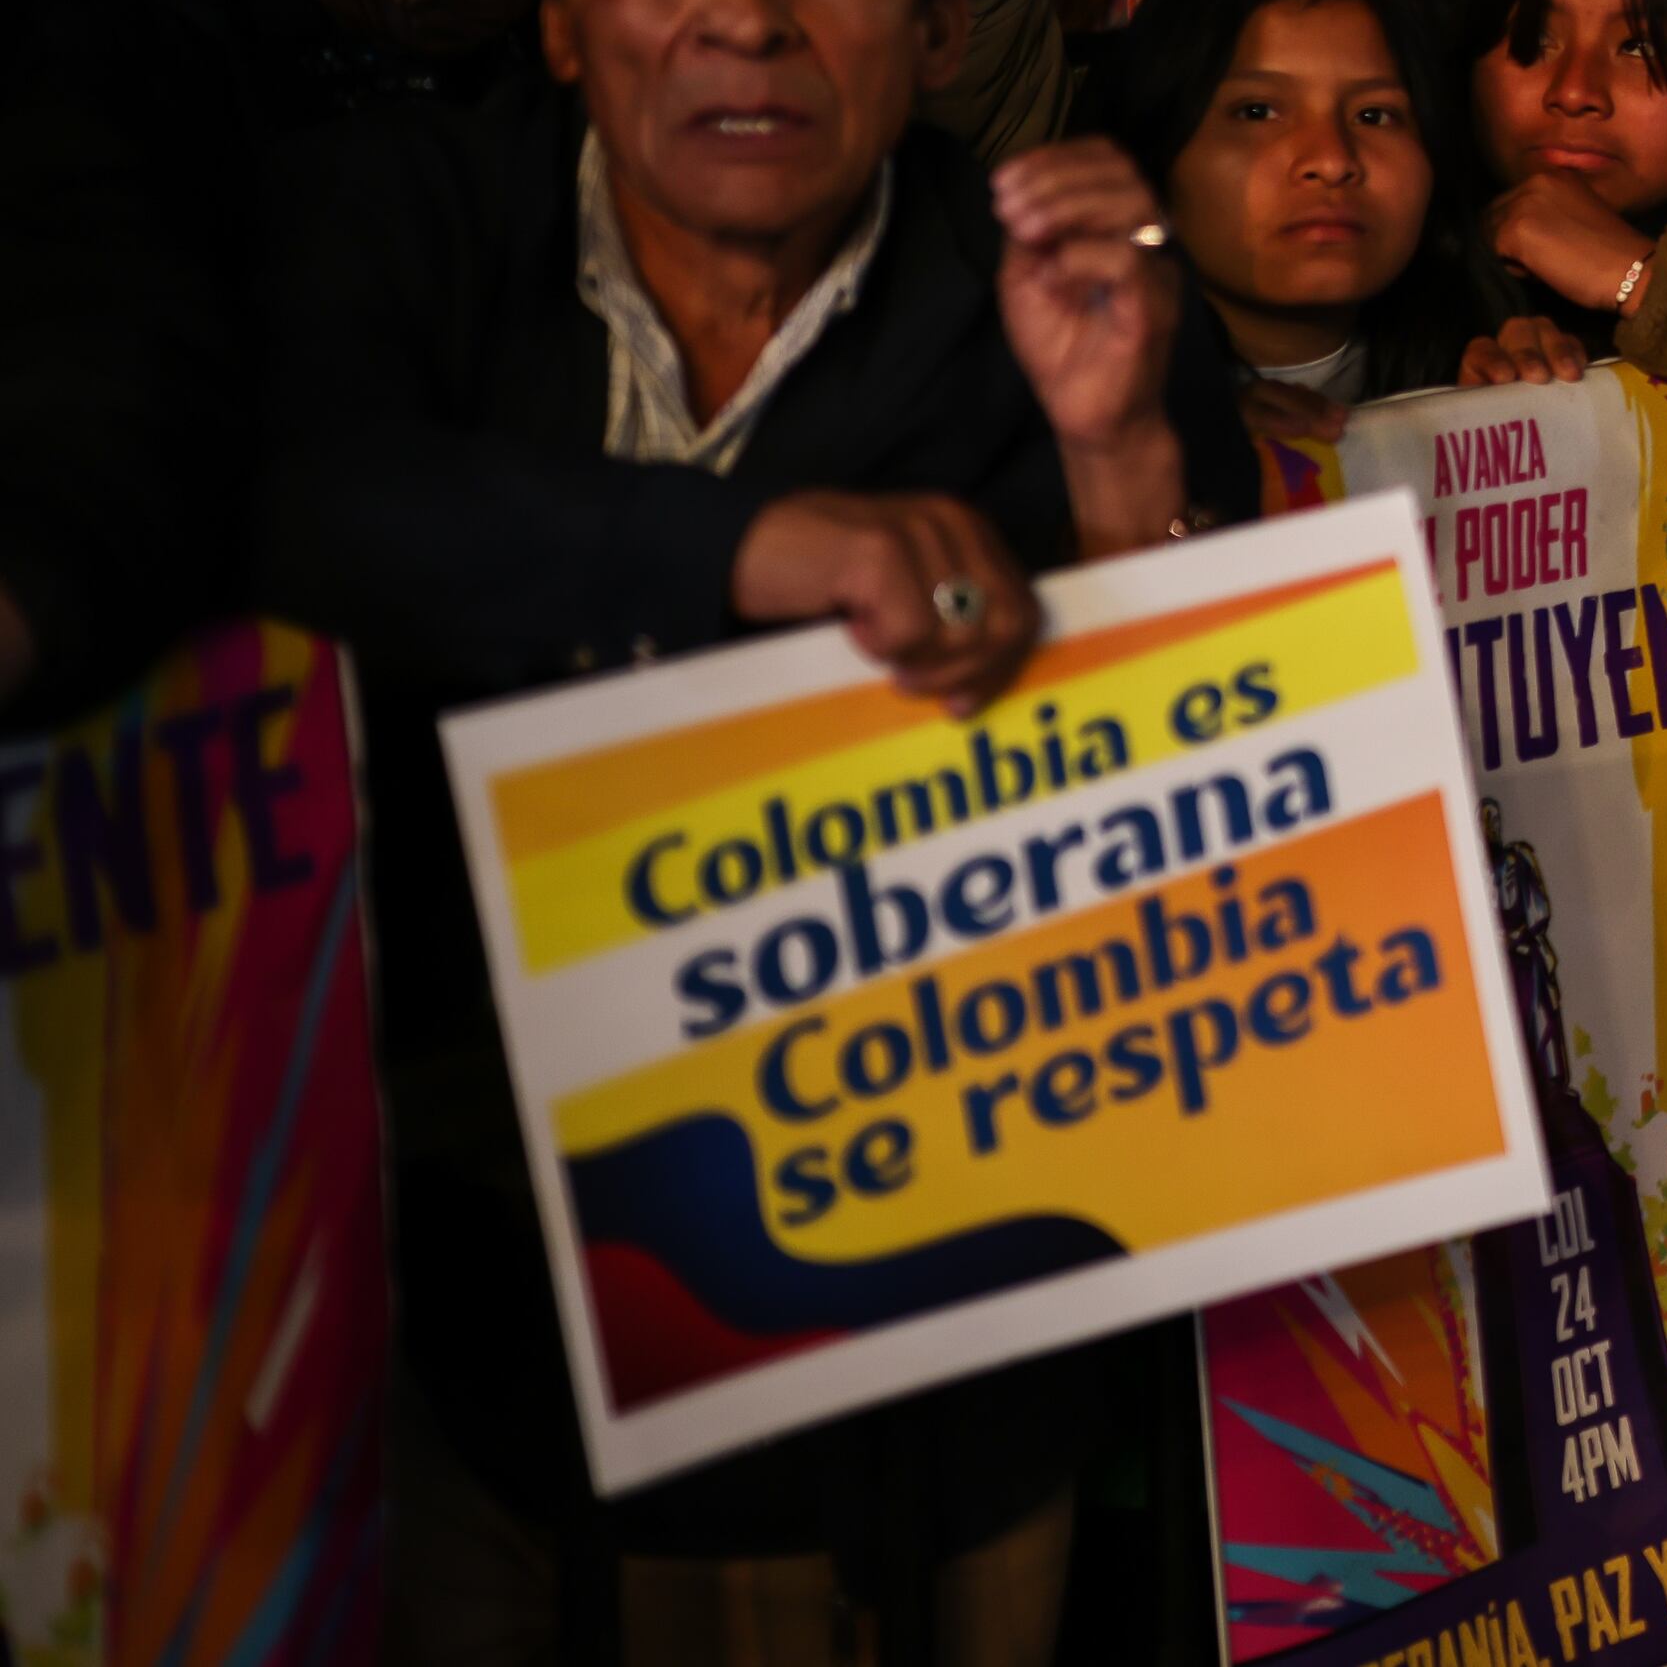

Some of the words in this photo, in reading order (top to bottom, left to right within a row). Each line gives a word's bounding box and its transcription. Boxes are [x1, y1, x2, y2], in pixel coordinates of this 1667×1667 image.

[1433, 418, 1548, 499] AVANZA
[1455, 487, 1589, 603] PODER
[622, 701, 1130, 931] Colombia
[1167, 659, 1282, 747] es
[671, 743, 1336, 1042] soberana
[753, 864, 1318, 1130] Colombia
[769, 1118, 916, 1231] se
[959, 922, 1446, 1160] respeta
[1550, 1264, 1597, 1343] 24
[1550, 1339, 1617, 1428] OCT
[1560, 1415, 1643, 1504] 4PM
[1548, 1552, 1647, 1662] PAZ
